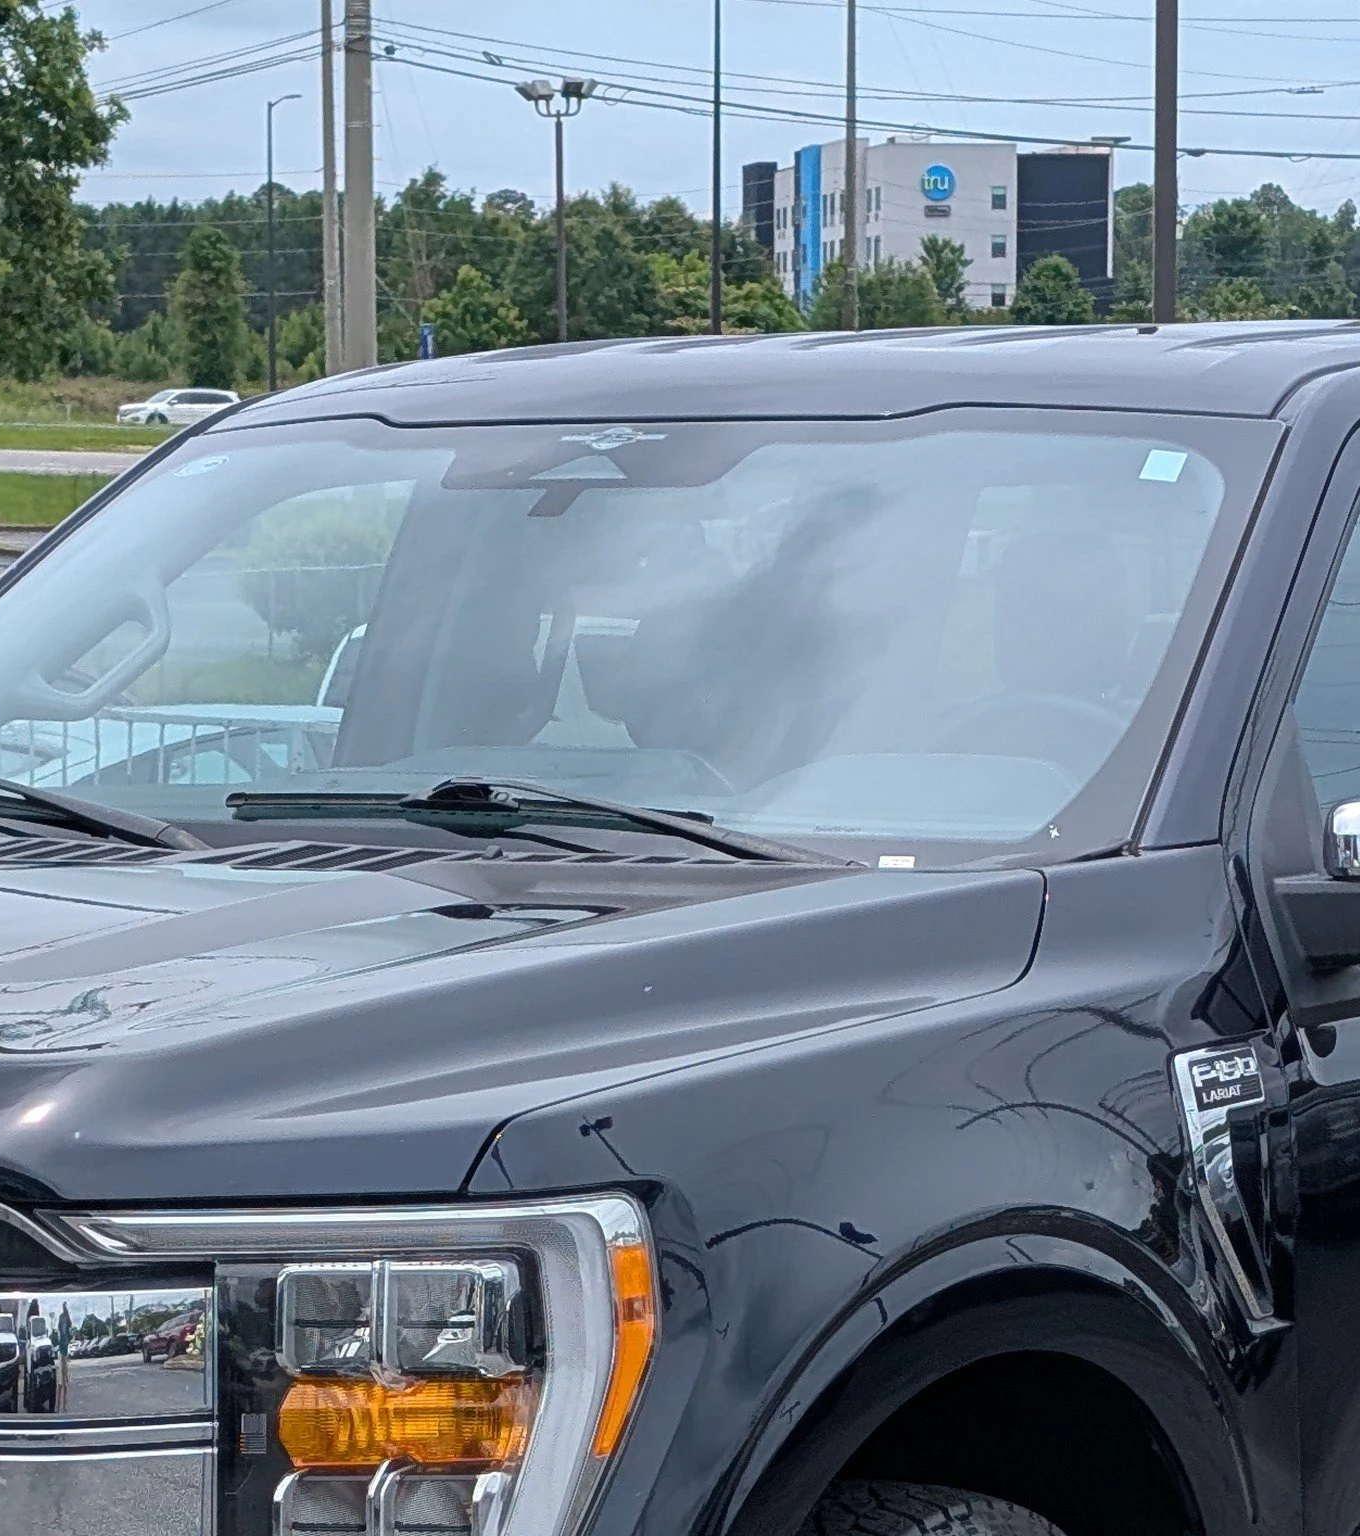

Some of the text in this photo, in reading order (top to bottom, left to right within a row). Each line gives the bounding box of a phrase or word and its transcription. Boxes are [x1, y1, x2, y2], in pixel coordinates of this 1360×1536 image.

[922, 173, 949, 190] tru
[1192, 1056, 1257, 1087] F-150
[1202, 1084, 1242, 1103] LARIAT
